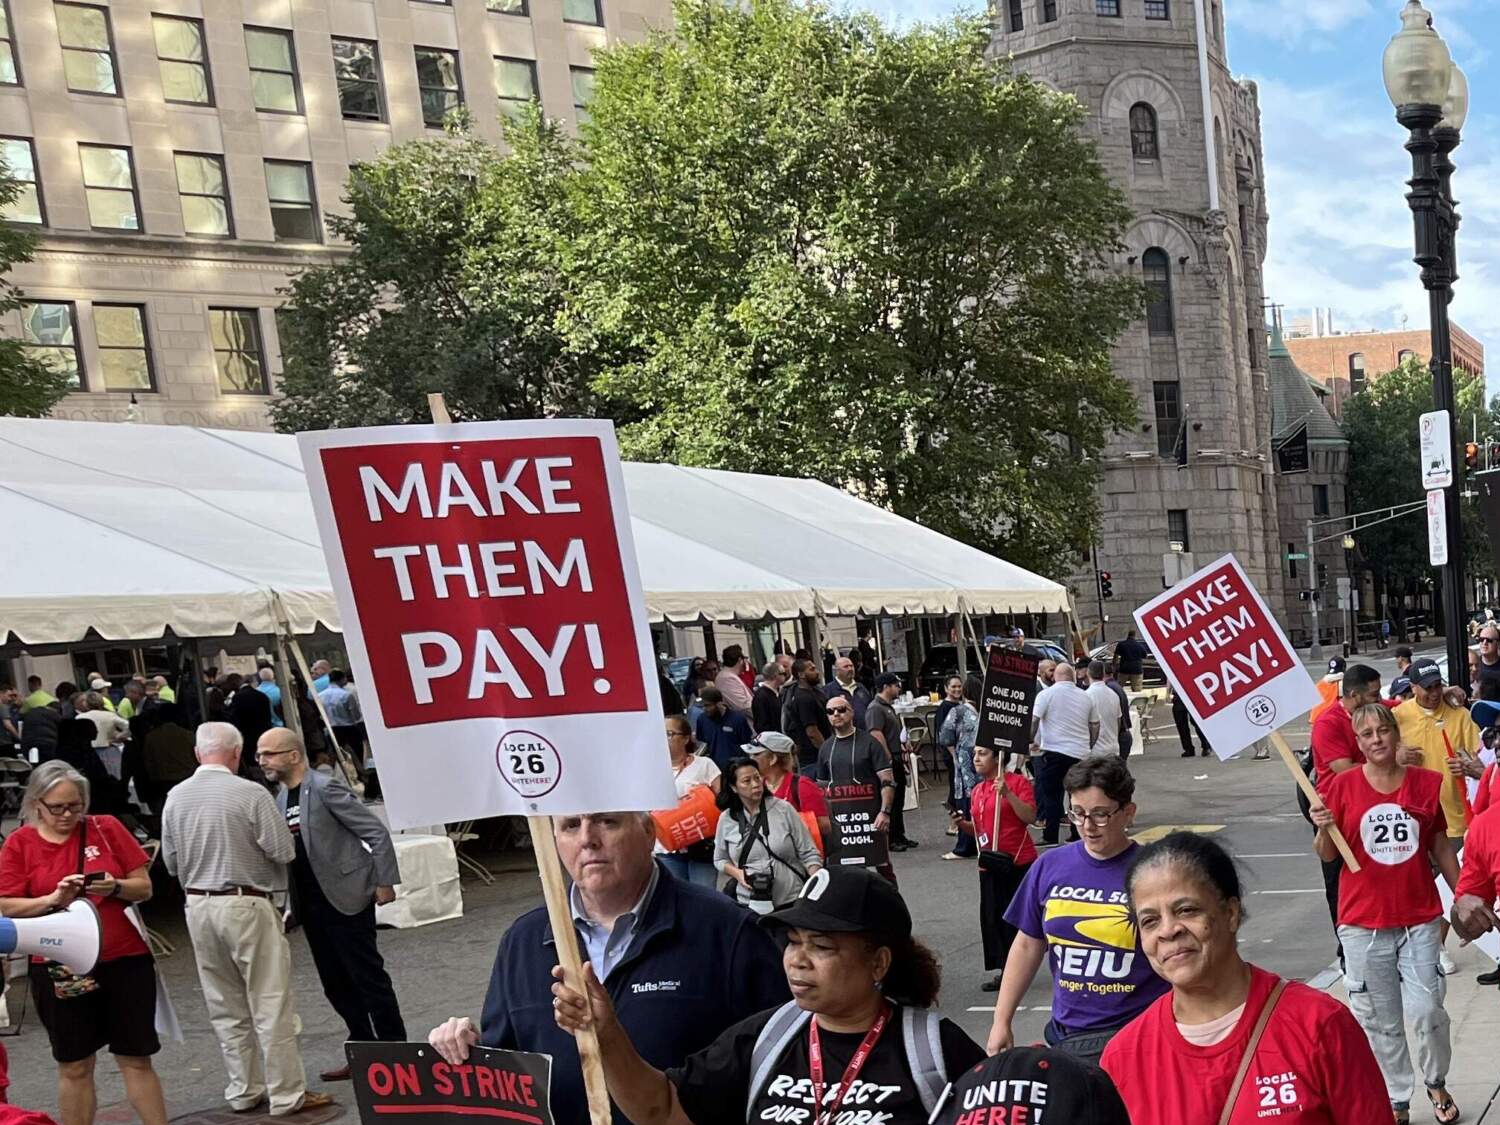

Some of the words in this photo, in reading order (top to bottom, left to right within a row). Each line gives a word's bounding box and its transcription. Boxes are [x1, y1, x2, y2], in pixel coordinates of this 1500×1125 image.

[57, 409, 150, 424] BOSTO
[358, 456, 581, 521] MAKE
[374, 538, 593, 601] THEM
[1153, 574, 1239, 639] MAKE
[1171, 605, 1256, 667] THEM
[401, 623, 611, 704] PAY!
[1193, 638, 1279, 707] PAY!
[992, 685, 1009, 698] ONE
[1010, 689, 1025, 700] JOB
[986, 698, 1016, 712] SHOULD
[1017, 705, 1029, 715] BE
[1252, 705, 1269, 719] 26
[988, 712, 1023, 727] ENOUGH.
[504, 743, 546, 752] LOCAL
[510, 753, 545, 774] 26
[834, 784, 874, 797] STRIKE
[834, 814, 848, 823] NE
[850, 812, 870, 821] JOB
[1368, 812, 1411, 823] LOCAL
[841, 824, 861, 834] ULD
[1373, 822, 1409, 844] 26
[841, 835, 874, 845] OUGH.
[1371, 845, 1413, 854] UNITEHERE!
[1050, 885, 1104, 902] LOCAL
[40, 937, 63, 946] PYLE
[1053, 944, 1135, 979] SEIU
[631, 981, 658, 993] Tufts
[1059, 979, 1085, 993] onger
[1087, 981, 1136, 995] Together
[367, 1062, 422, 1096] ON
[431, 1062, 539, 1108] STRIKE
[1255, 1071, 1297, 1086] LOCAL
[963, 1080, 1048, 1110] UNITE
[1258, 1082, 1297, 1107] 26
[760, 1104, 811, 1125] OUR
